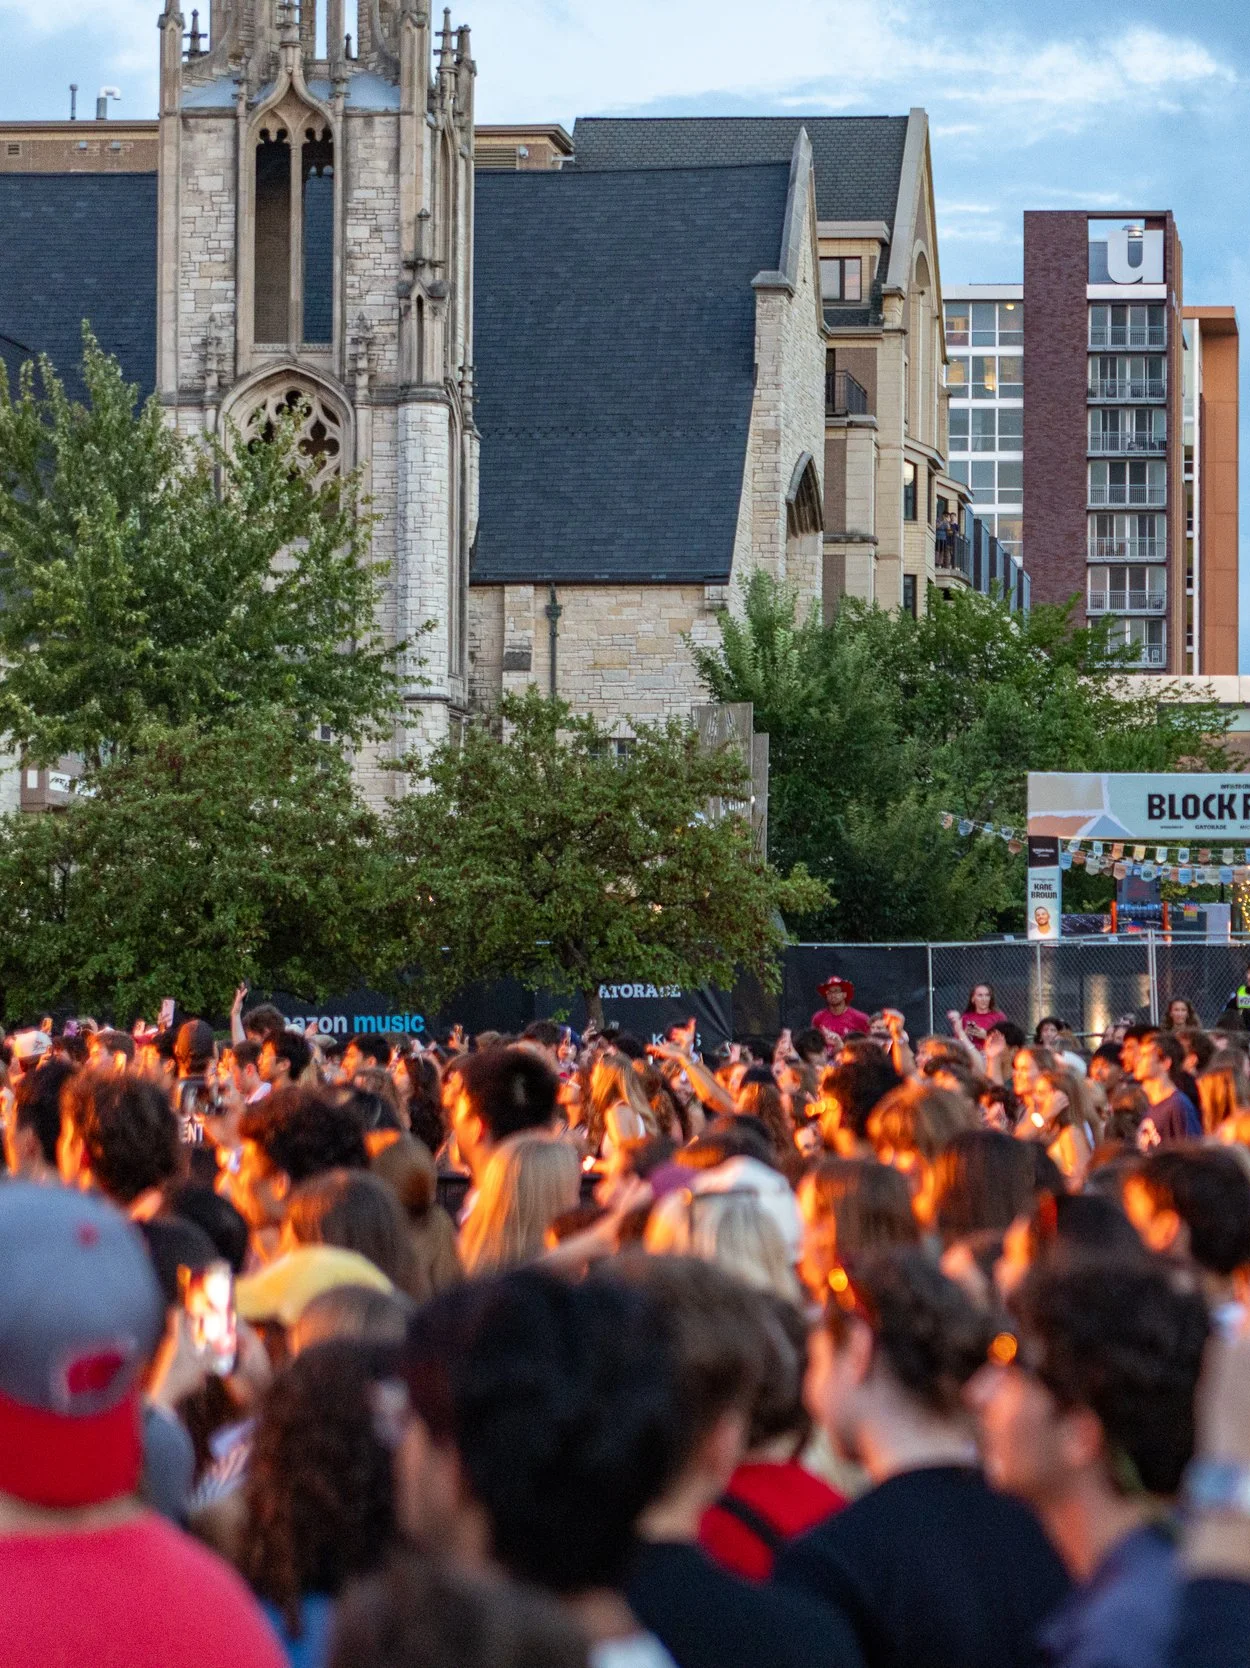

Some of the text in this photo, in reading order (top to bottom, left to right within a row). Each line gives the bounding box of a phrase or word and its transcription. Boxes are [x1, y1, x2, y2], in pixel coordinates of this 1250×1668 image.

[1148, 793, 1237, 820] BLOCK
[1031, 891, 1057, 899] BROWN
[353, 1012, 425, 1033] music
